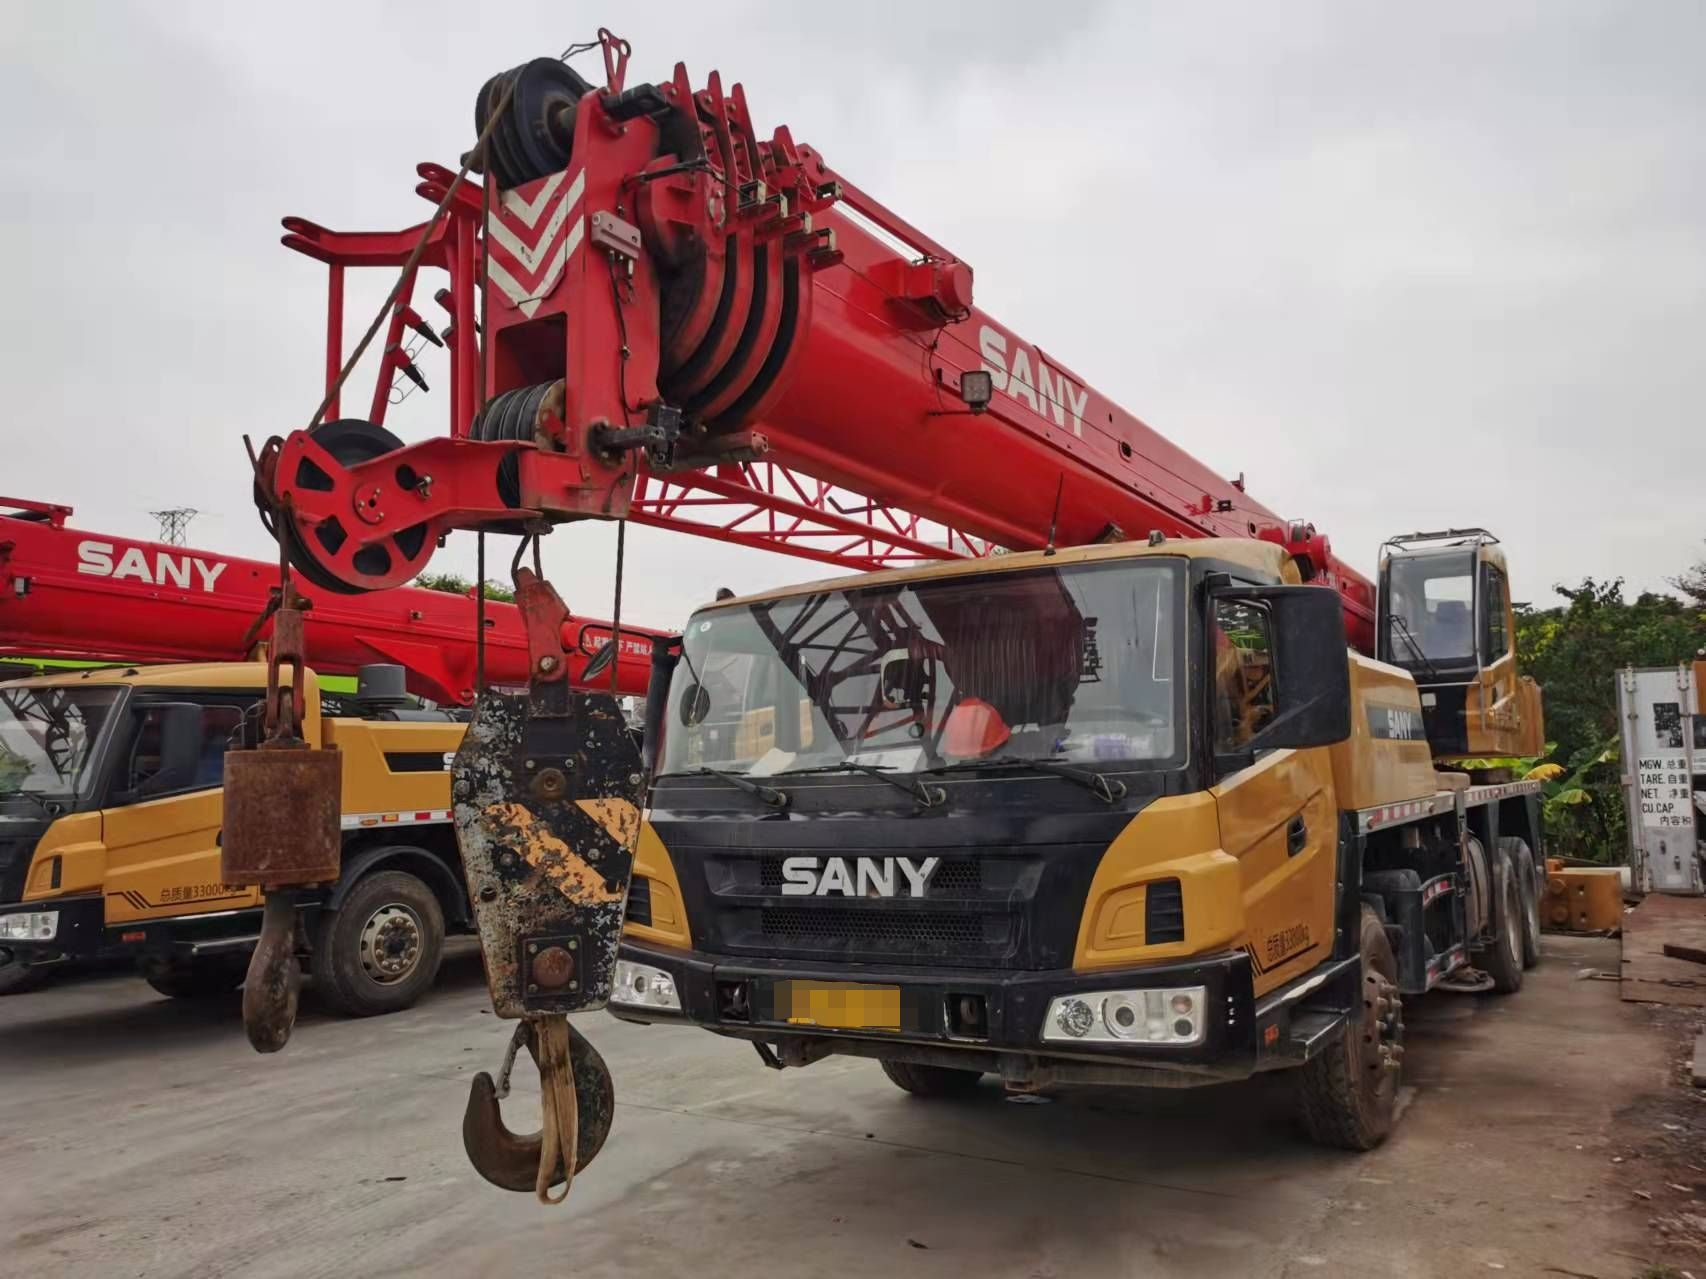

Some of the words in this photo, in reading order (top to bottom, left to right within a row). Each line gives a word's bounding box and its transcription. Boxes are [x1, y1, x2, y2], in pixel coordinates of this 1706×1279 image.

[979, 325, 1089, 438] SANY
[77, 540, 228, 592] SANY
[1667, 759, 1687, 769] 总重
[1668, 774, 1688, 784] 自重
[782, 857, 939, 898] SANY
